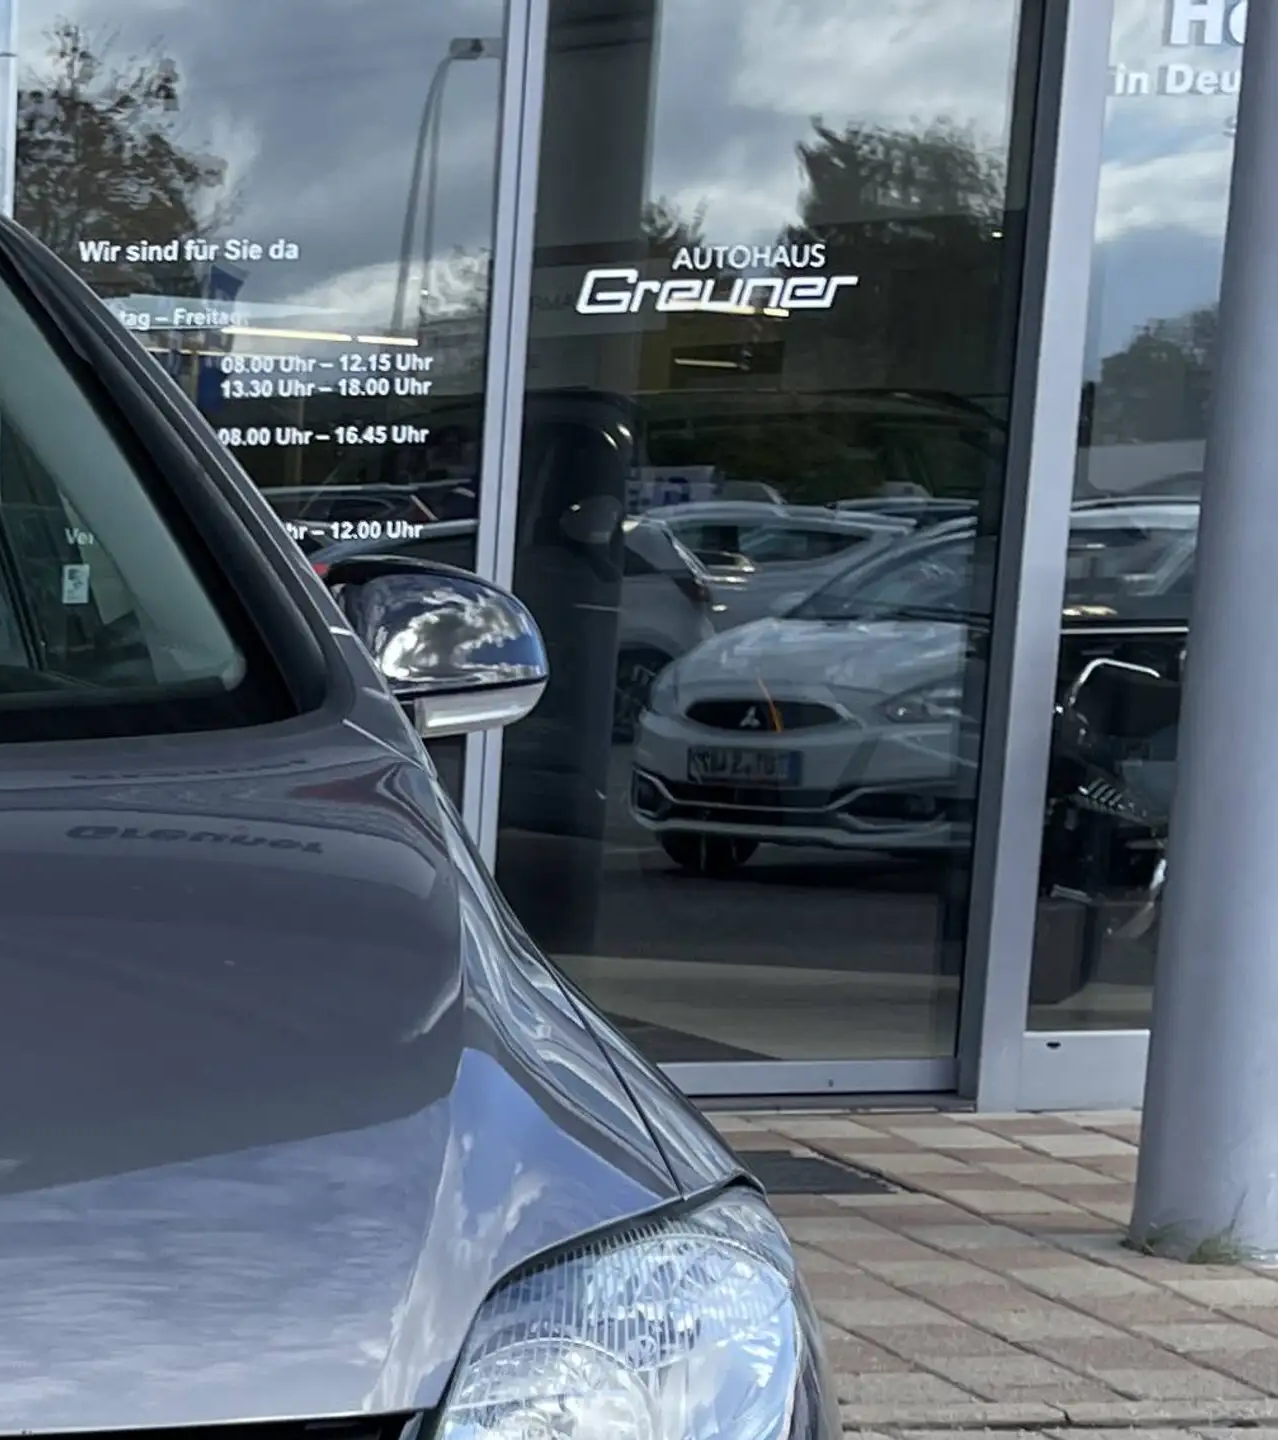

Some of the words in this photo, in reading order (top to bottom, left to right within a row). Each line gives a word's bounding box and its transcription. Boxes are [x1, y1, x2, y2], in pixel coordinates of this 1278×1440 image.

[1113, 61, 1150, 94] in
[79, 239, 120, 262] Wir
[126, 240, 178, 262] sind
[184, 238, 219, 261] für
[224, 239, 263, 260] Sie
[269, 238, 299, 259] da
[672, 243, 826, 271] AUTOHAUS
[575, 268, 859, 316] Greuner
[221, 357, 273, 373] 08.00
[279, 356, 316, 372] Uhr
[340, 355, 390, 372] 12.15
[396, 353, 433, 371] Uhr
[221, 380, 273, 398] 13.30
[278, 380, 315, 396] Uhr
[338, 378, 388, 396] 18.00
[395, 378, 432, 395] Uhr
[218, 428, 270, 445] 08.00
[276, 427, 313, 444] Uhr
[335, 426, 387, 443] 16.45
[392, 426, 429, 443] Uhr
[332, 522, 380, 540] 12.00
[387, 521, 423, 538] Uhr
